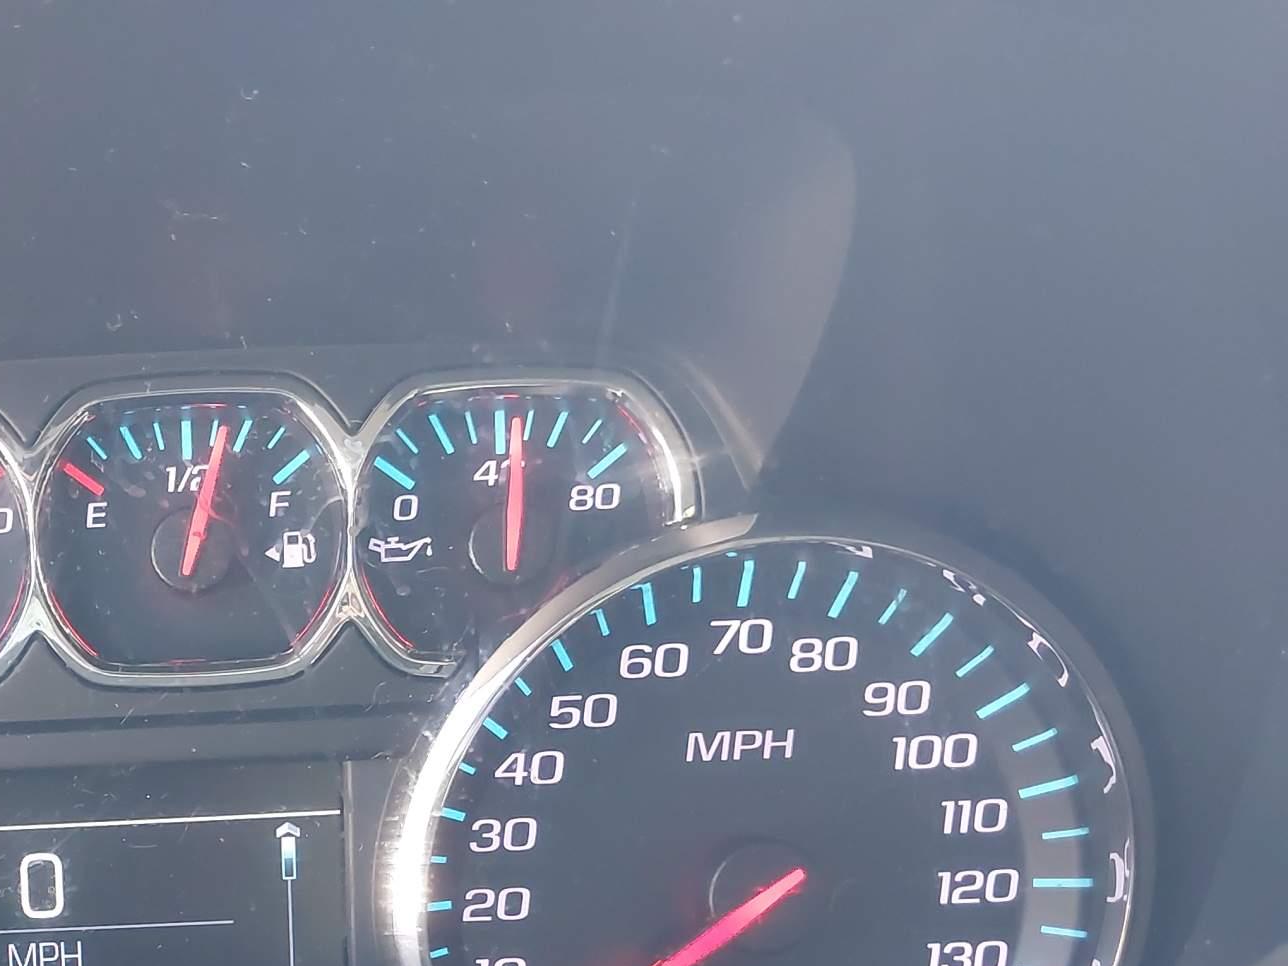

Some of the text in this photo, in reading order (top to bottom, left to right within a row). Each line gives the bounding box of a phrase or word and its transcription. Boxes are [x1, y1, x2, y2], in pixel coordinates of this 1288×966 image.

[270, 491, 291, 516] F
[394, 495, 418, 520] 0
[570, 484, 620, 510] 80
[87, 502, 107, 528] E
[711, 619, 772, 654] 70
[620, 644, 688, 678] 60
[790, 637, 858, 672] 80
[549, 694, 617, 728] 50
[863, 681, 930, 716] 90
[687, 729, 794, 761] MPH
[893, 734, 977, 769] 100
[495, 751, 564, 785] 40
[942, 799, 1007, 834] 110
[470, 818, 537, 852] 30
[20, 853, 64, 918] 0
[938, 869, 1019, 904] 120
[463, 888, 530, 921] 20
